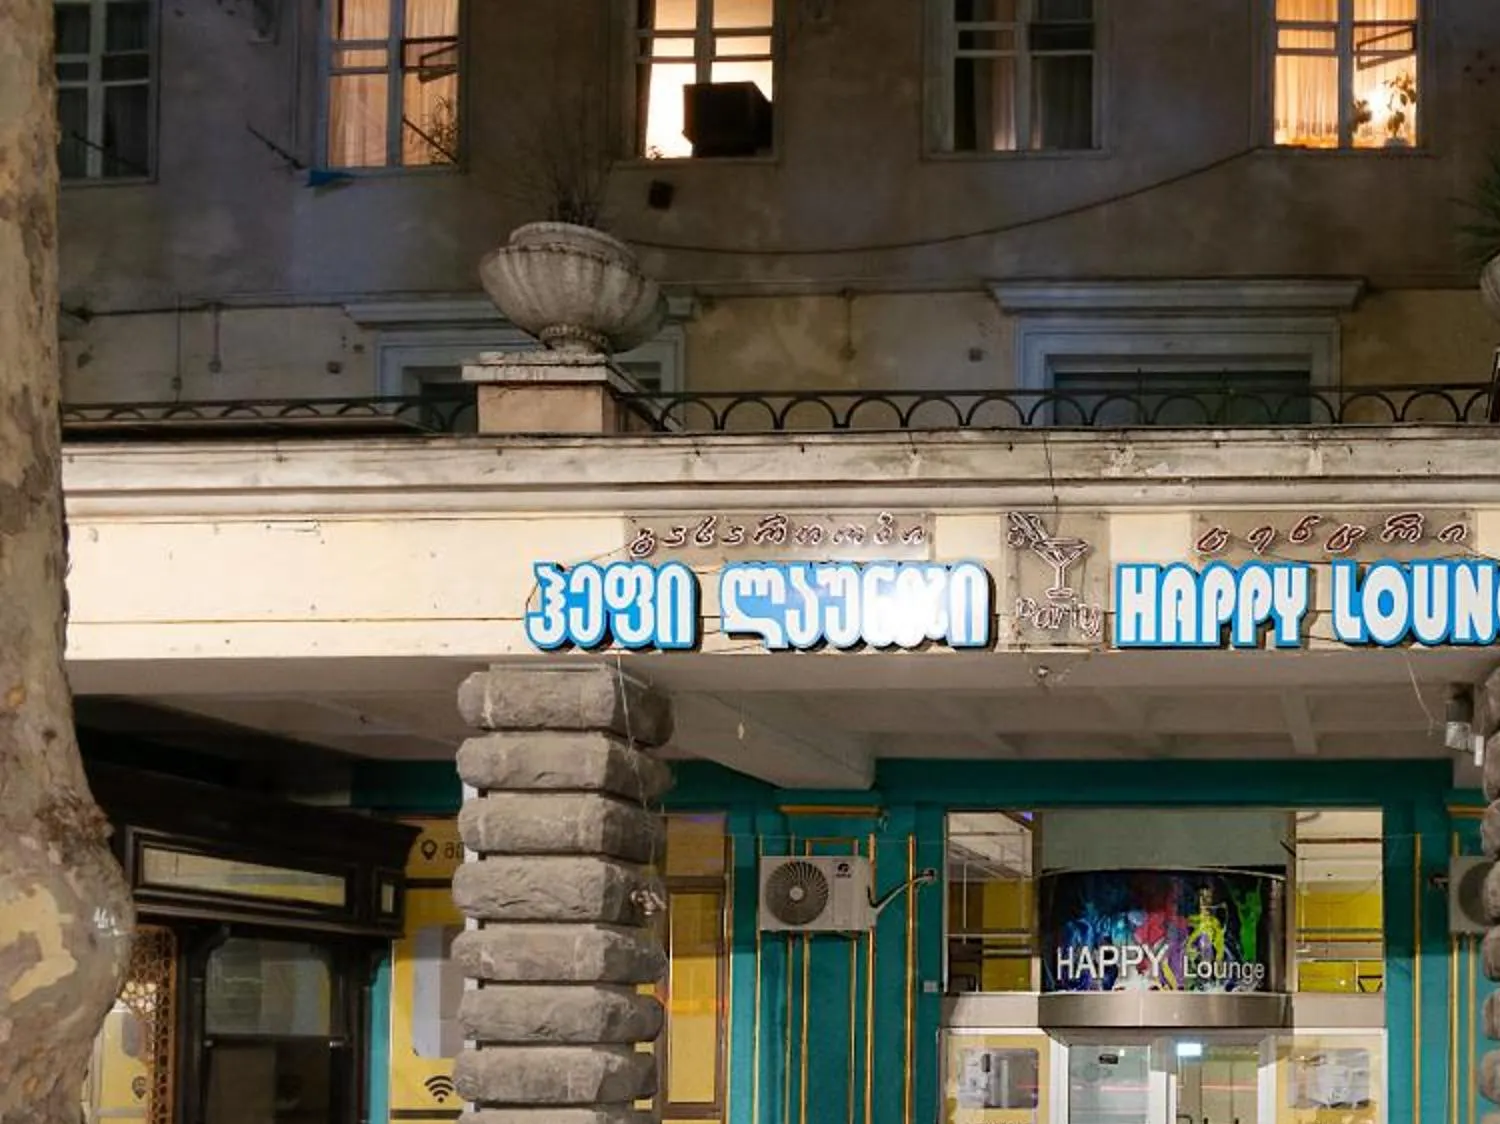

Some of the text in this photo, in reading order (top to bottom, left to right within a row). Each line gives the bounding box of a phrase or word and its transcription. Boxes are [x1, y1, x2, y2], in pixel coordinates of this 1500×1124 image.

[526, 561, 698, 651] ჰეფი
[1115, 561, 1310, 648] HAPPY
[1056, 944, 1265, 983] HAPPY Lounge
